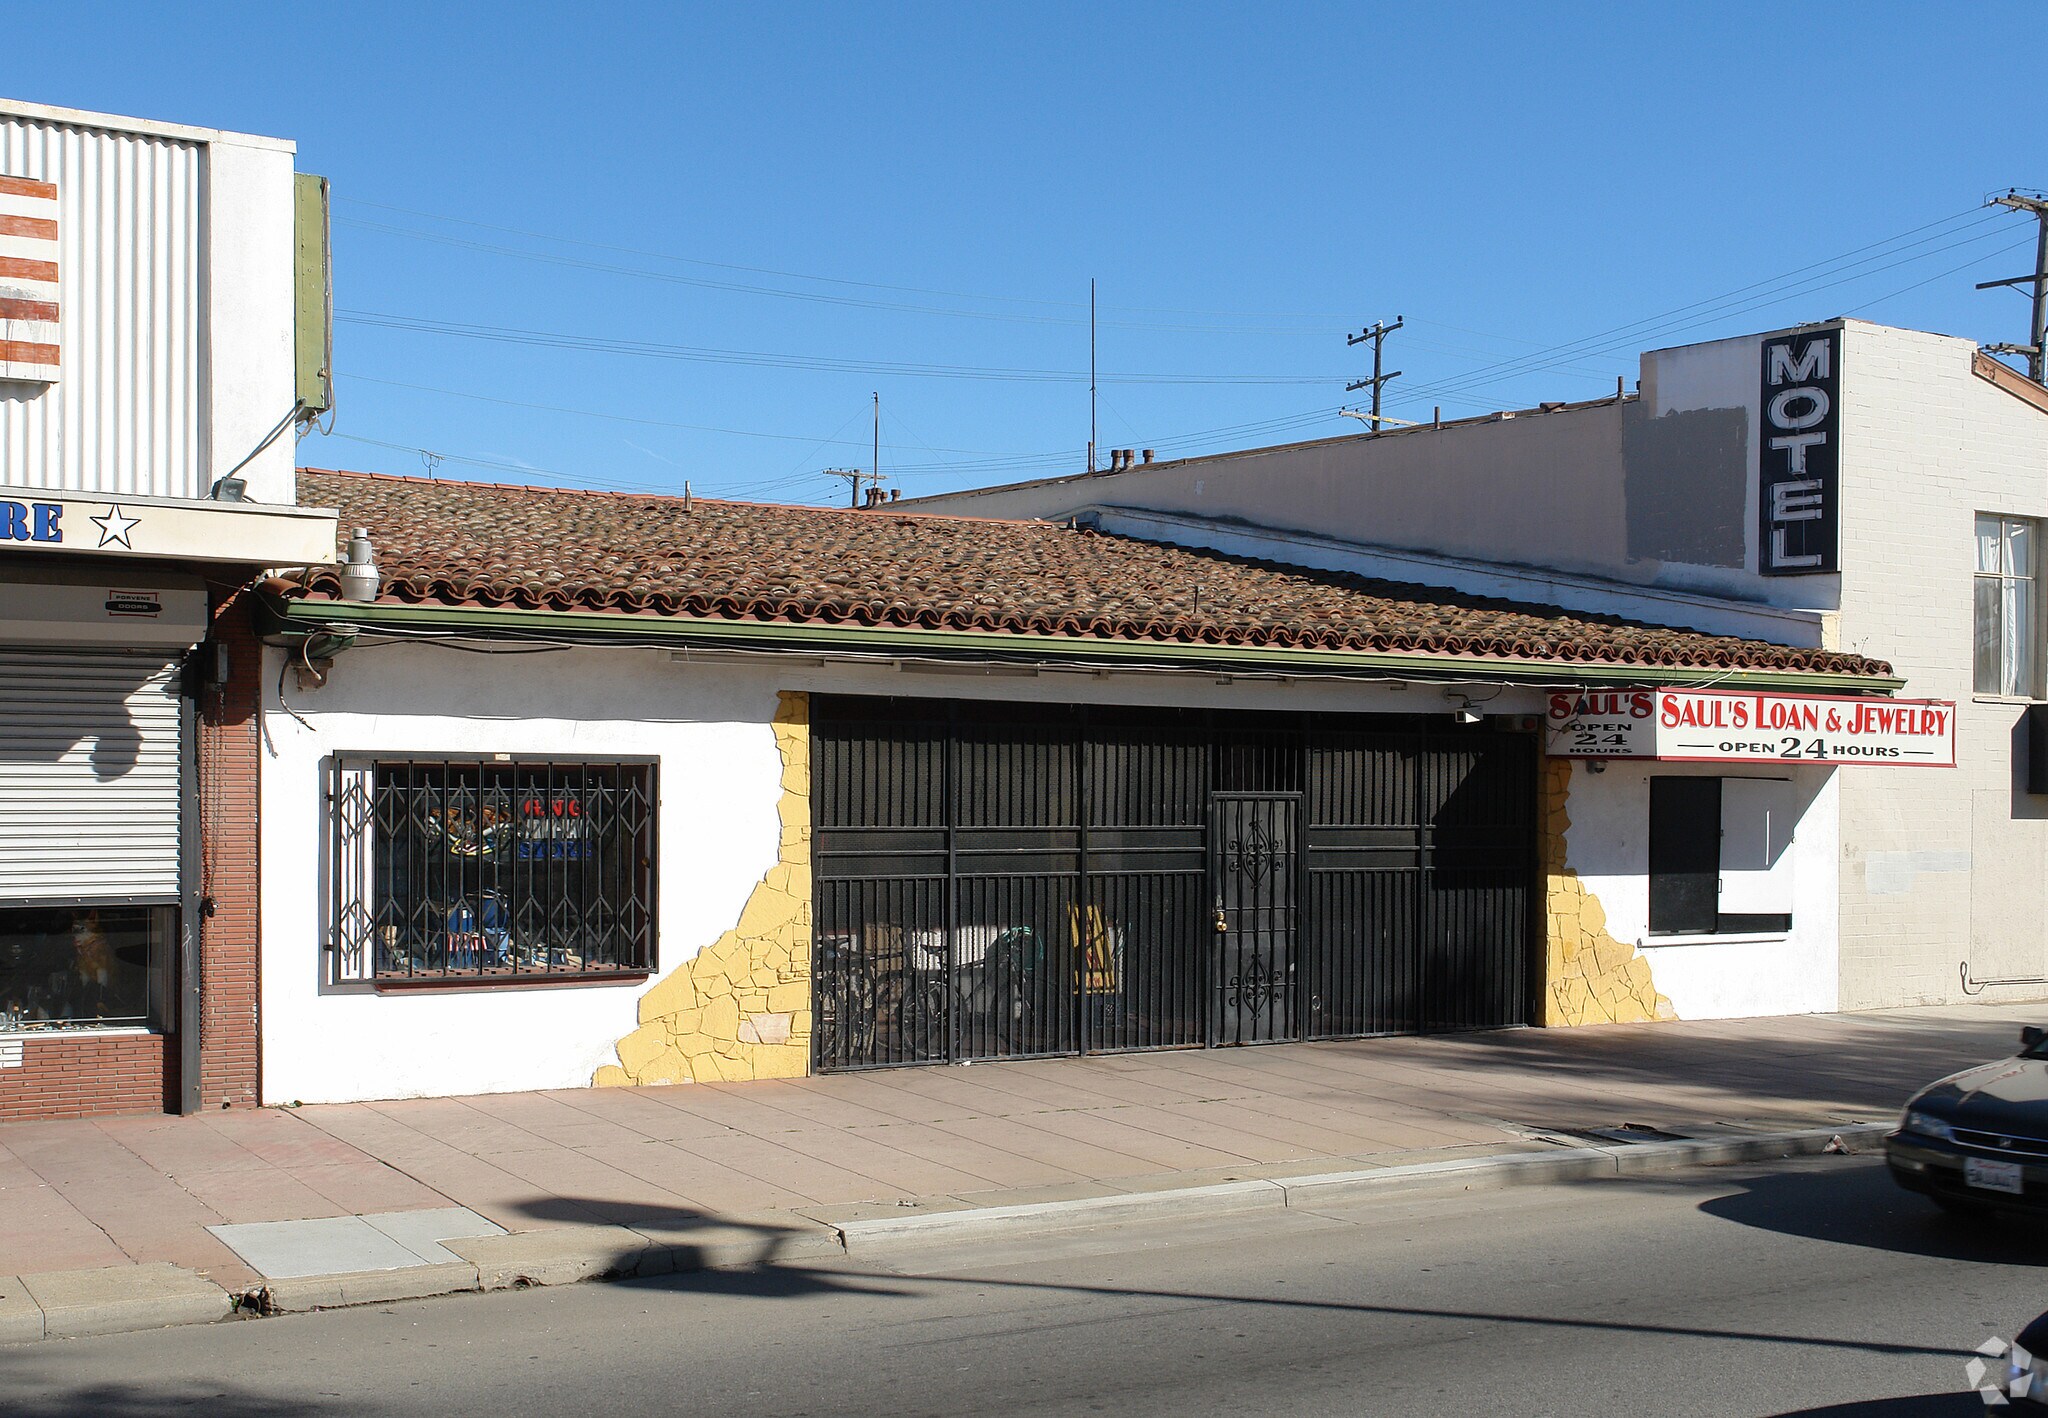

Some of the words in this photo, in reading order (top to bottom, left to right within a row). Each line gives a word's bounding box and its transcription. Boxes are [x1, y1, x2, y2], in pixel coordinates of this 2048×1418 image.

[1767, 338, 1830, 568] MOTEL
[0, 501, 63, 543] RE
[1549, 692, 1653, 719] SAUL'S
[1660, 694, 1748, 729] SAUL'S
[1755, 697, 1818, 731] LOAN
[1826, 708, 1842, 733] &
[1847, 703, 1949, 736] JEWELRY
[1570, 723, 1632, 732] OPEN
[1574, 733, 1628, 746] 24
[1718, 741, 1775, 753] OPEN
[1780, 737, 1828, 759] 24
[1833, 746, 1900, 757] HOURS
